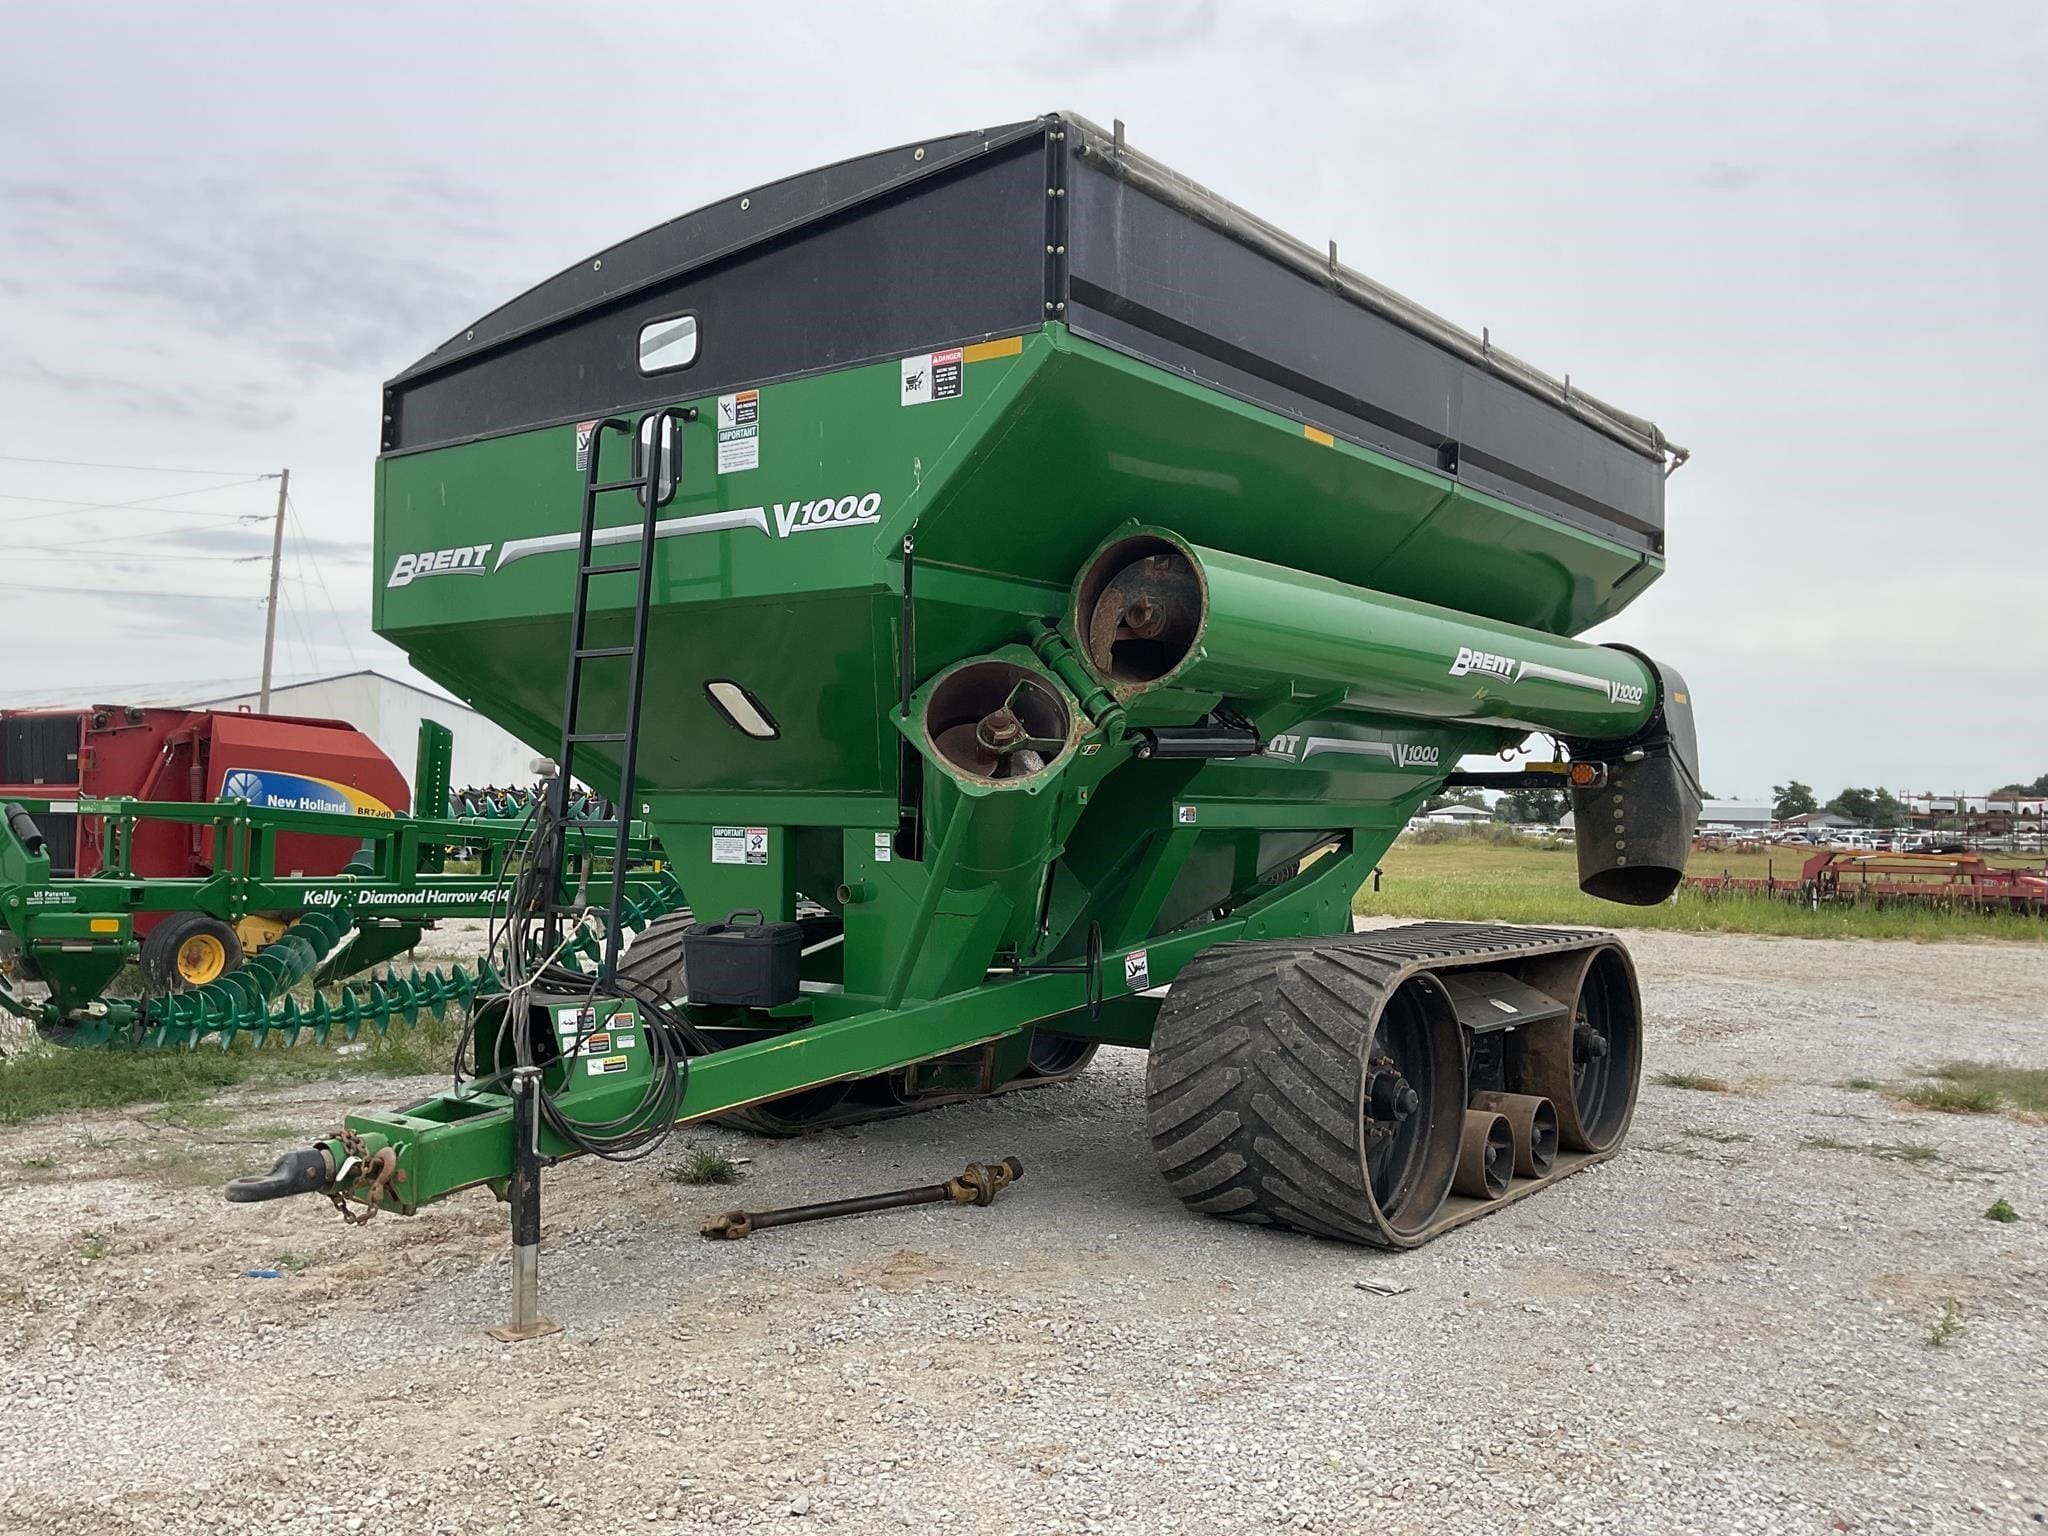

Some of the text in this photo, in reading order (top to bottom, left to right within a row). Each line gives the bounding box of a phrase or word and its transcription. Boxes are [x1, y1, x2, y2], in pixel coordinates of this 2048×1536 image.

[939, 351, 961, 361] DANGER
[719, 426, 756, 442] IMPORTANT
[387, 492, 882, 588] BRENT V1000
[1448, 646, 1643, 704] BRENT V1000
[1396, 743, 1439, 768] V1000
[267, 794, 346, 813] New Holland
[714, 828, 744, 837] IMPORTANT
[303, 889, 342, 908] Kelly
[358, 889, 427, 905] Diamond
[426, 889, 478, 904] Harrow
